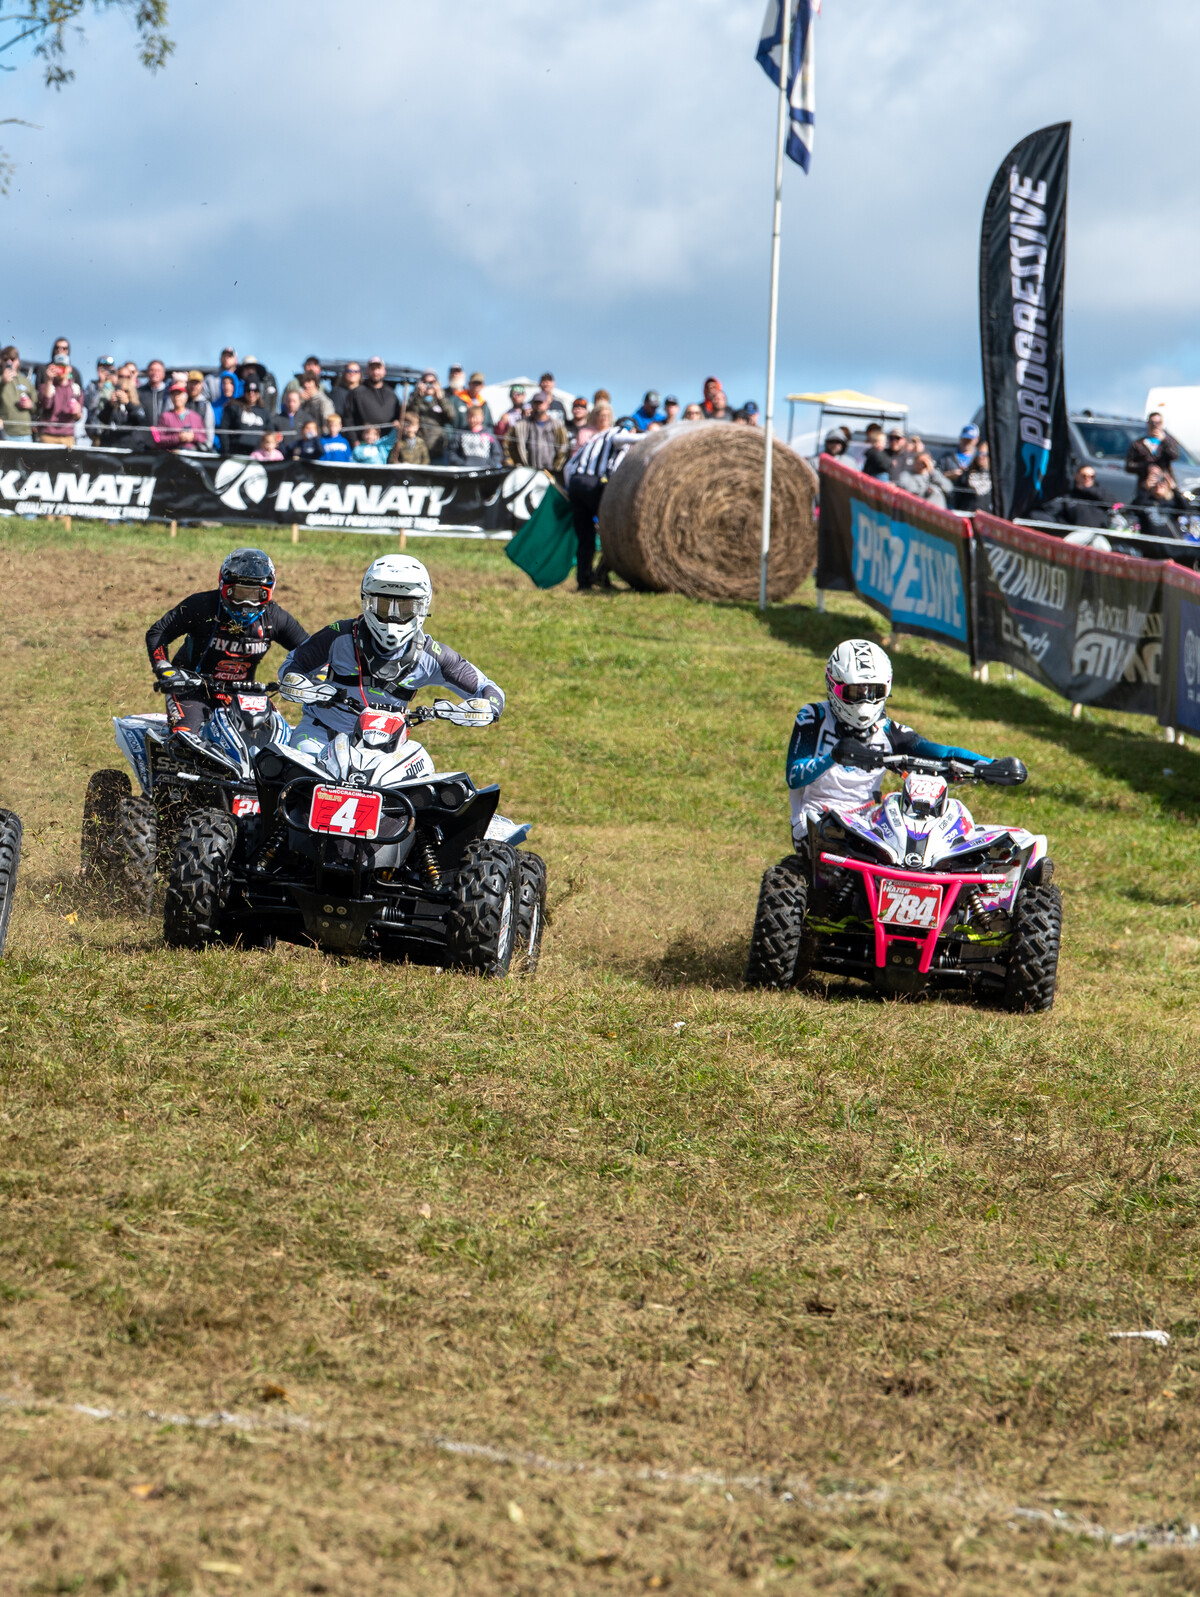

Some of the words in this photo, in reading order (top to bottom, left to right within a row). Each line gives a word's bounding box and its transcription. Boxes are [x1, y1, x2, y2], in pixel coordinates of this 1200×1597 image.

[1009, 164, 1052, 450] PROGRESSIVE
[274, 481, 445, 516] KANATI
[210, 637, 229, 652] FLY
[240, 697, 267, 708] 202
[369, 716, 388, 730] 4
[909, 779, 942, 798] 784
[329, 797, 360, 833] 4
[882, 892, 938, 926] 784
